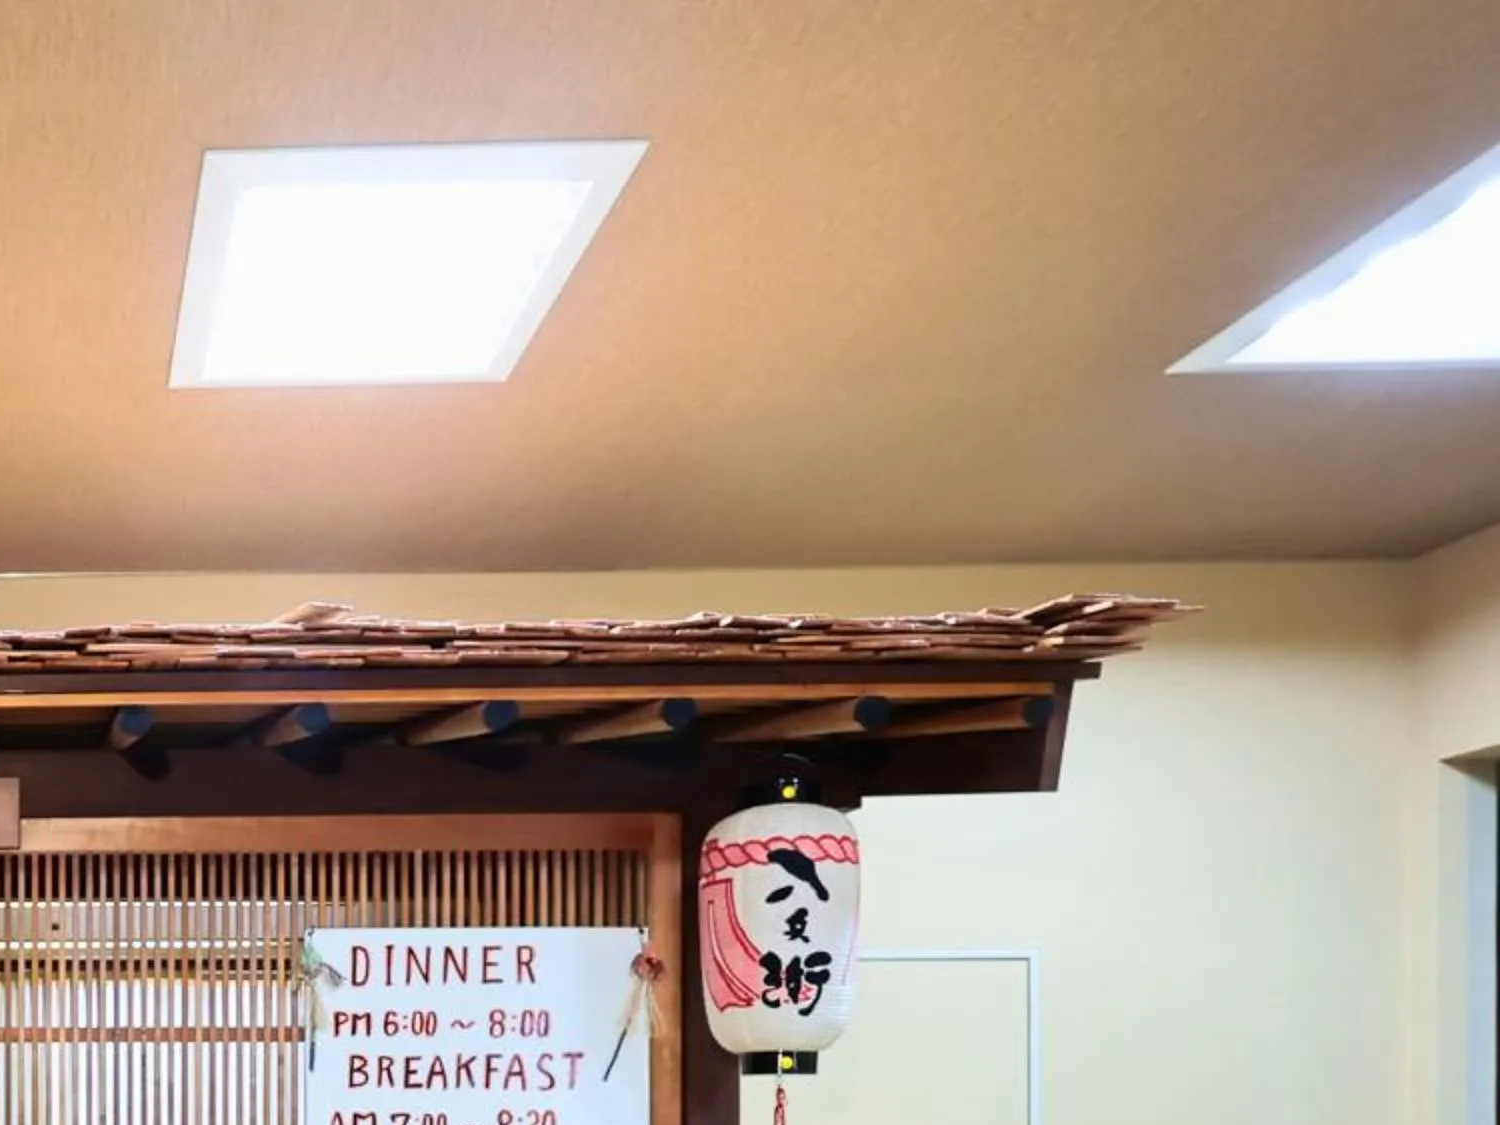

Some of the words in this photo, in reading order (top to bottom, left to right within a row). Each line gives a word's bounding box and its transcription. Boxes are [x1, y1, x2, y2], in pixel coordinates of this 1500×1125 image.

[350, 943, 538, 988] DINNER
[332, 1010, 372, 1038] PM
[383, 1009, 439, 1038] 6:00
[487, 1008, 551, 1039] 8:00
[348, 1051, 585, 1092] BREAKFAST
